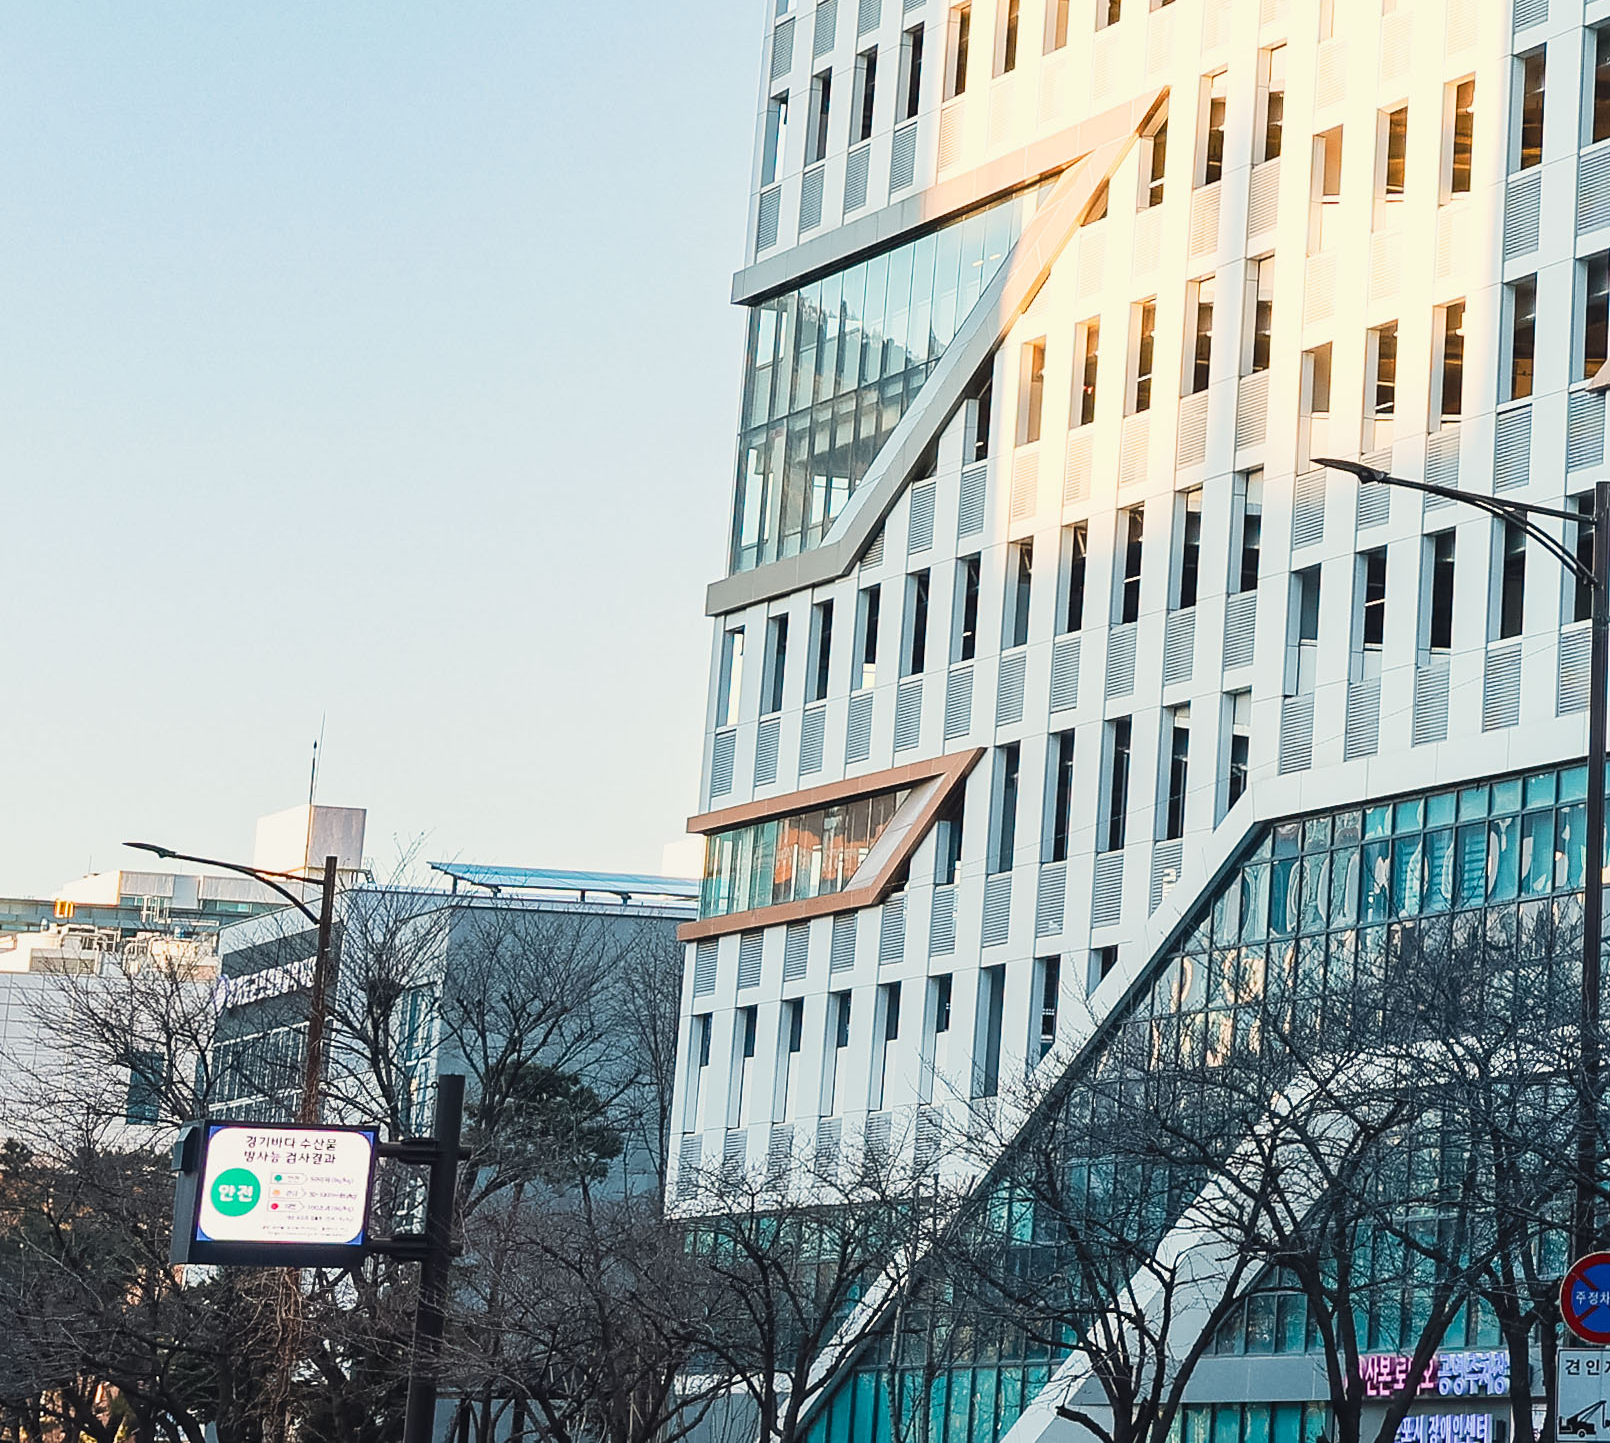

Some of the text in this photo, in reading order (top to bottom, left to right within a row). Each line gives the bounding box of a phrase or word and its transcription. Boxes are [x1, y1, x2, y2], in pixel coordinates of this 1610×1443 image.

[246, 1135, 337, 1151] 경기바다 수산물
[286, 1152, 336, 1165] 검사결과
[218, 1184, 254, 1203] 안전
[1365, 1355, 1392, 1396] 산본
[1394, 1355, 1435, 1396] 로오
